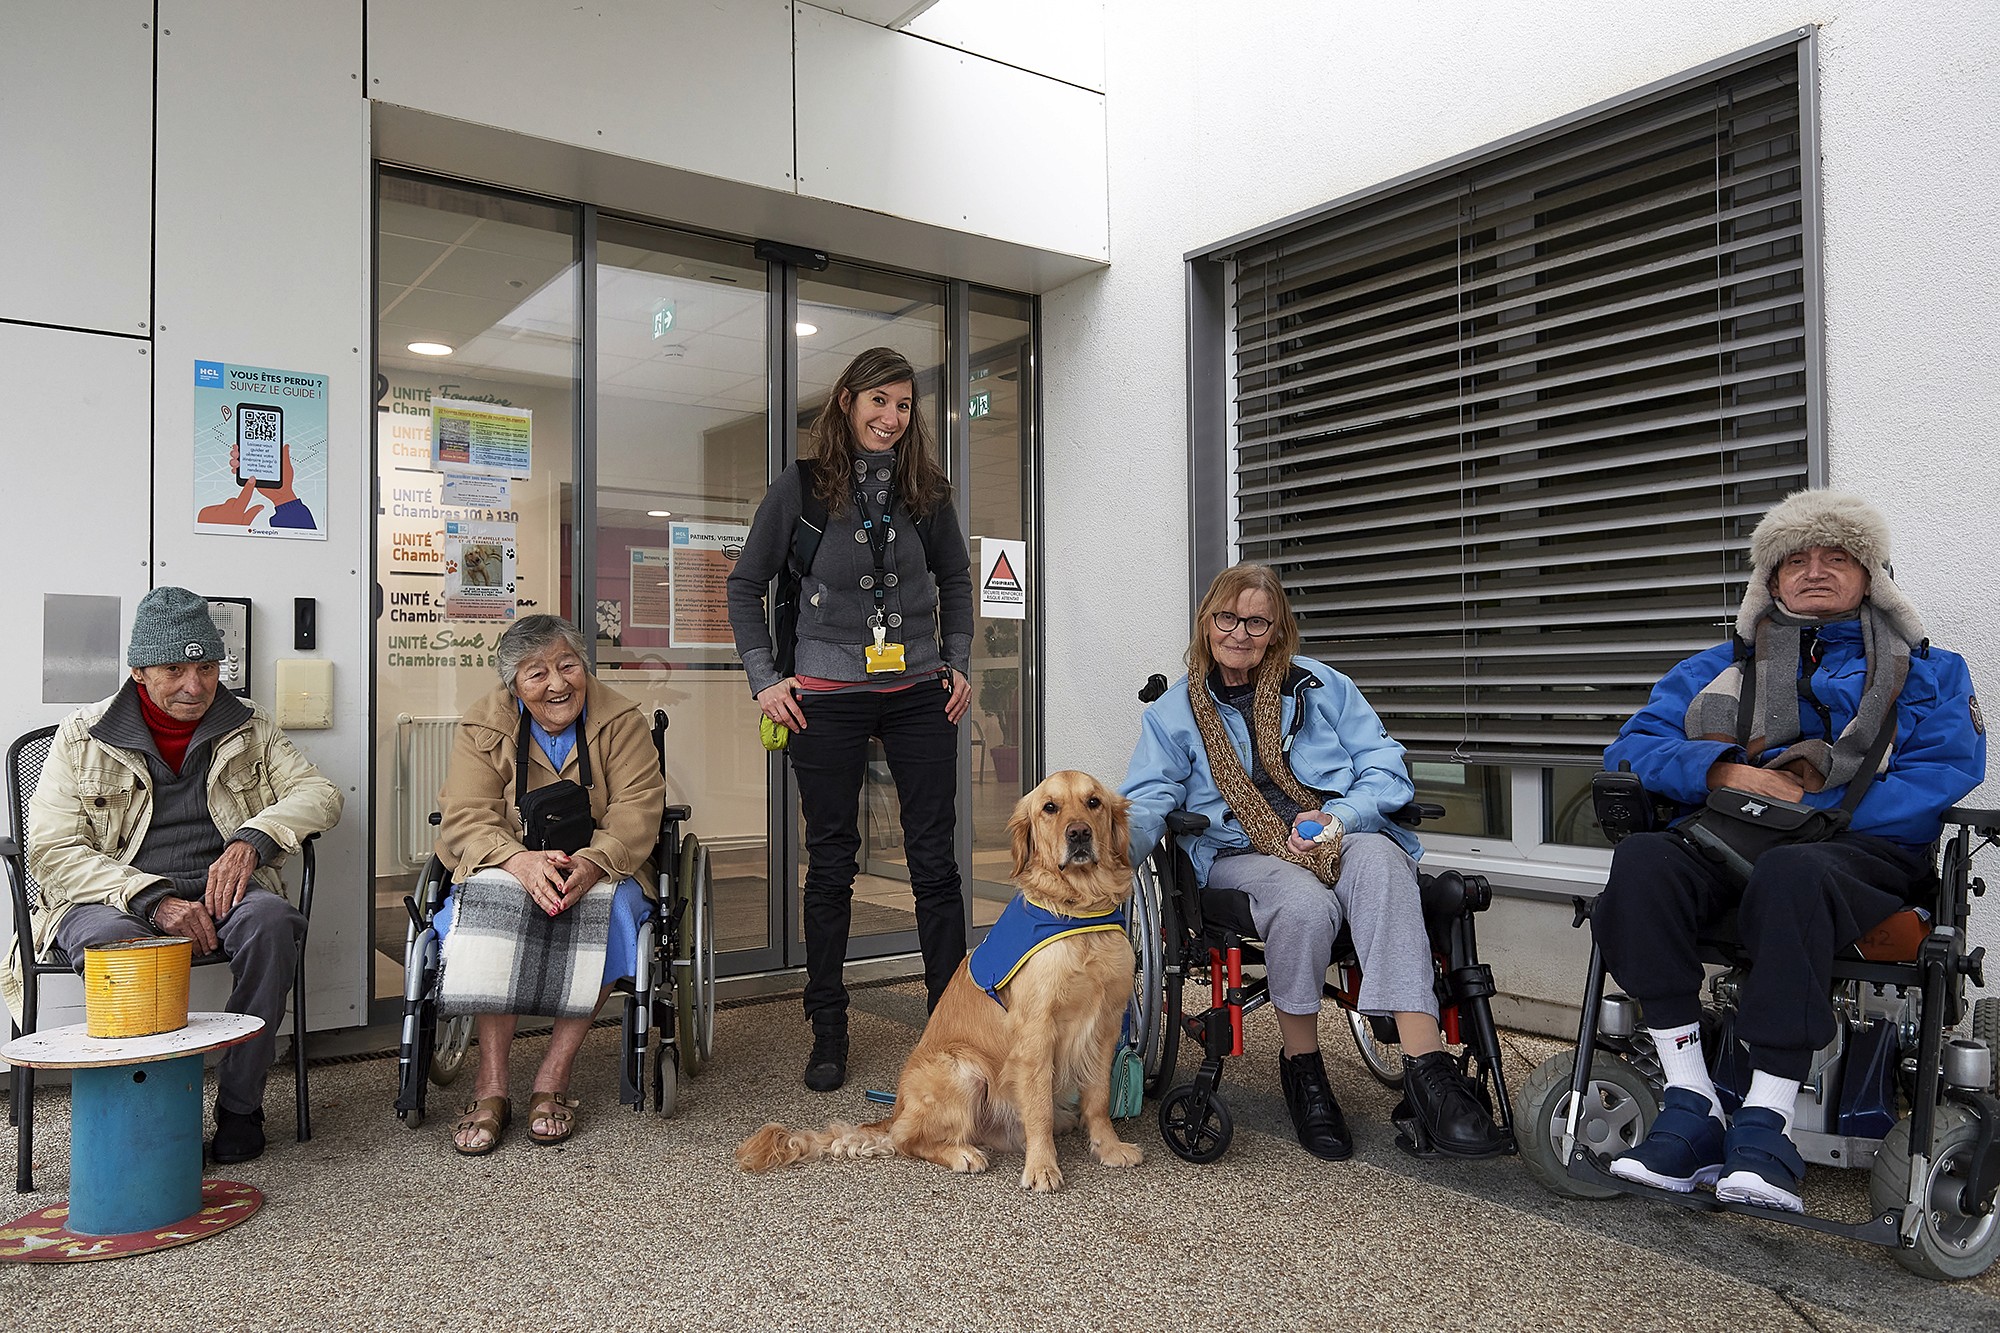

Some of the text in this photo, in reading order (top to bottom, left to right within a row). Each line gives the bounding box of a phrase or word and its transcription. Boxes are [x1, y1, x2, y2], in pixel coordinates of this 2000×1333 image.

[200, 368, 219, 376] HCL
[230, 370, 258, 380] VOUS
[262, 372, 281, 383] ÊTES
[284, 377, 314, 386] PERDU
[230, 381, 266, 393] SUIVEZ
[270, 386, 279, 394] LE
[283, 387, 315, 398] GUIDE
[392, 387, 432, 402] UNITÉ
[392, 402, 430, 417] Cham
[392, 426, 431, 440] UNITÉ
[392, 444, 431, 458] Cham
[393, 488, 432, 503] UNITÉ
[393, 504, 460, 519] Chambres
[464, 509, 481, 520] 101
[486, 510, 493, 521] à
[497, 511, 518, 522] 130
[393, 532, 432, 547] UNITÉ
[393, 548, 444, 562] Chambr
[391, 591, 430, 605] UNITÉ
[388, 635, 427, 649] UNITÉ
[430, 630, 484, 650] Saint
[388, 653, 456, 667] Chambres
[460, 654, 472, 667] 31
[477, 654, 484, 667] à
[1675, 1031, 1699, 1050] FIL
